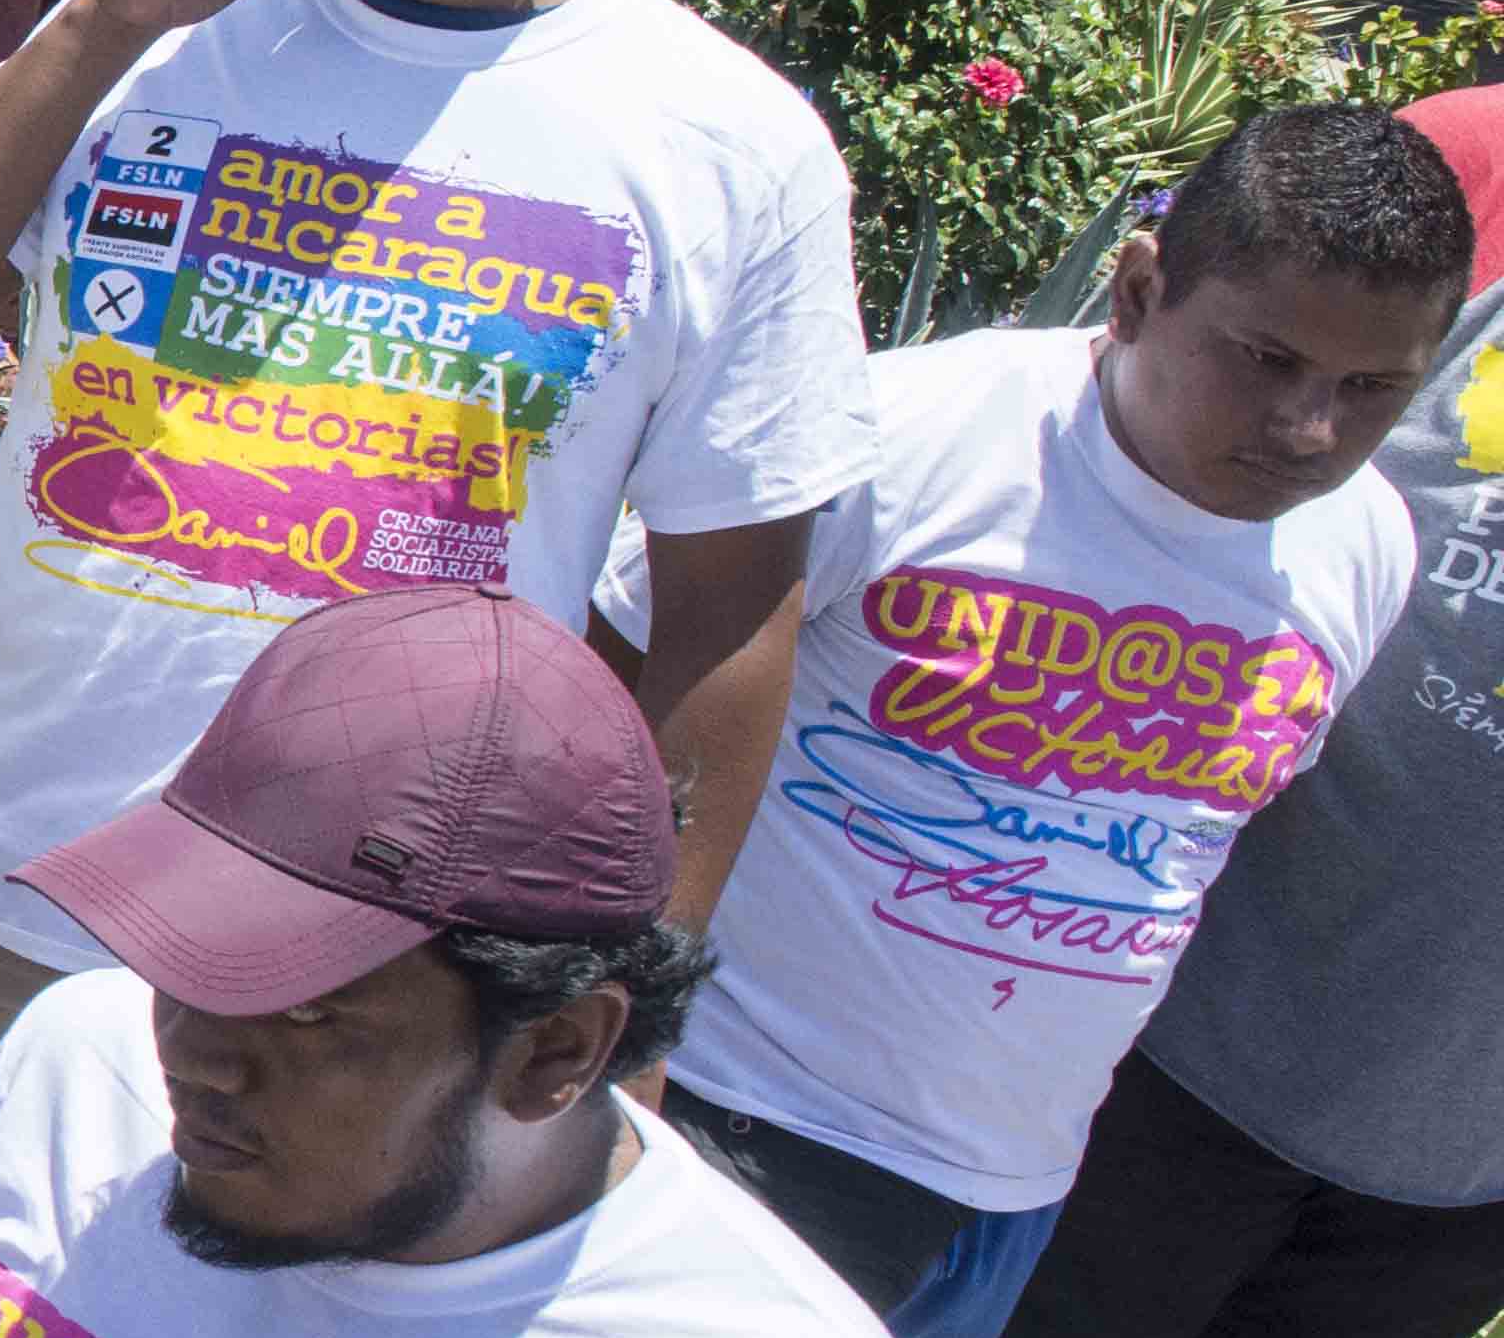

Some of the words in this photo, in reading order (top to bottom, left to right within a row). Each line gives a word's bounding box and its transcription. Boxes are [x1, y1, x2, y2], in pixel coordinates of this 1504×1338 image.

[144, 124, 178, 158] 2
[115, 163, 185, 188] FSLN
[218, 147, 421, 227] amor
[433, 193, 488, 241] a
[100, 204, 169, 231] FSLN
[199, 198, 619, 331] nicaragua
[198, 252, 480, 354] SIEMPRE
[179, 293, 319, 369] MAS
[71, 359, 136, 407] en
[369, 528, 508, 565] SOCIALISTA
[377, 507, 503, 545] CRISTIANA
[361, 549, 496, 582] SOLIDARIA!
[878, 574, 1232, 708] UNID@S
